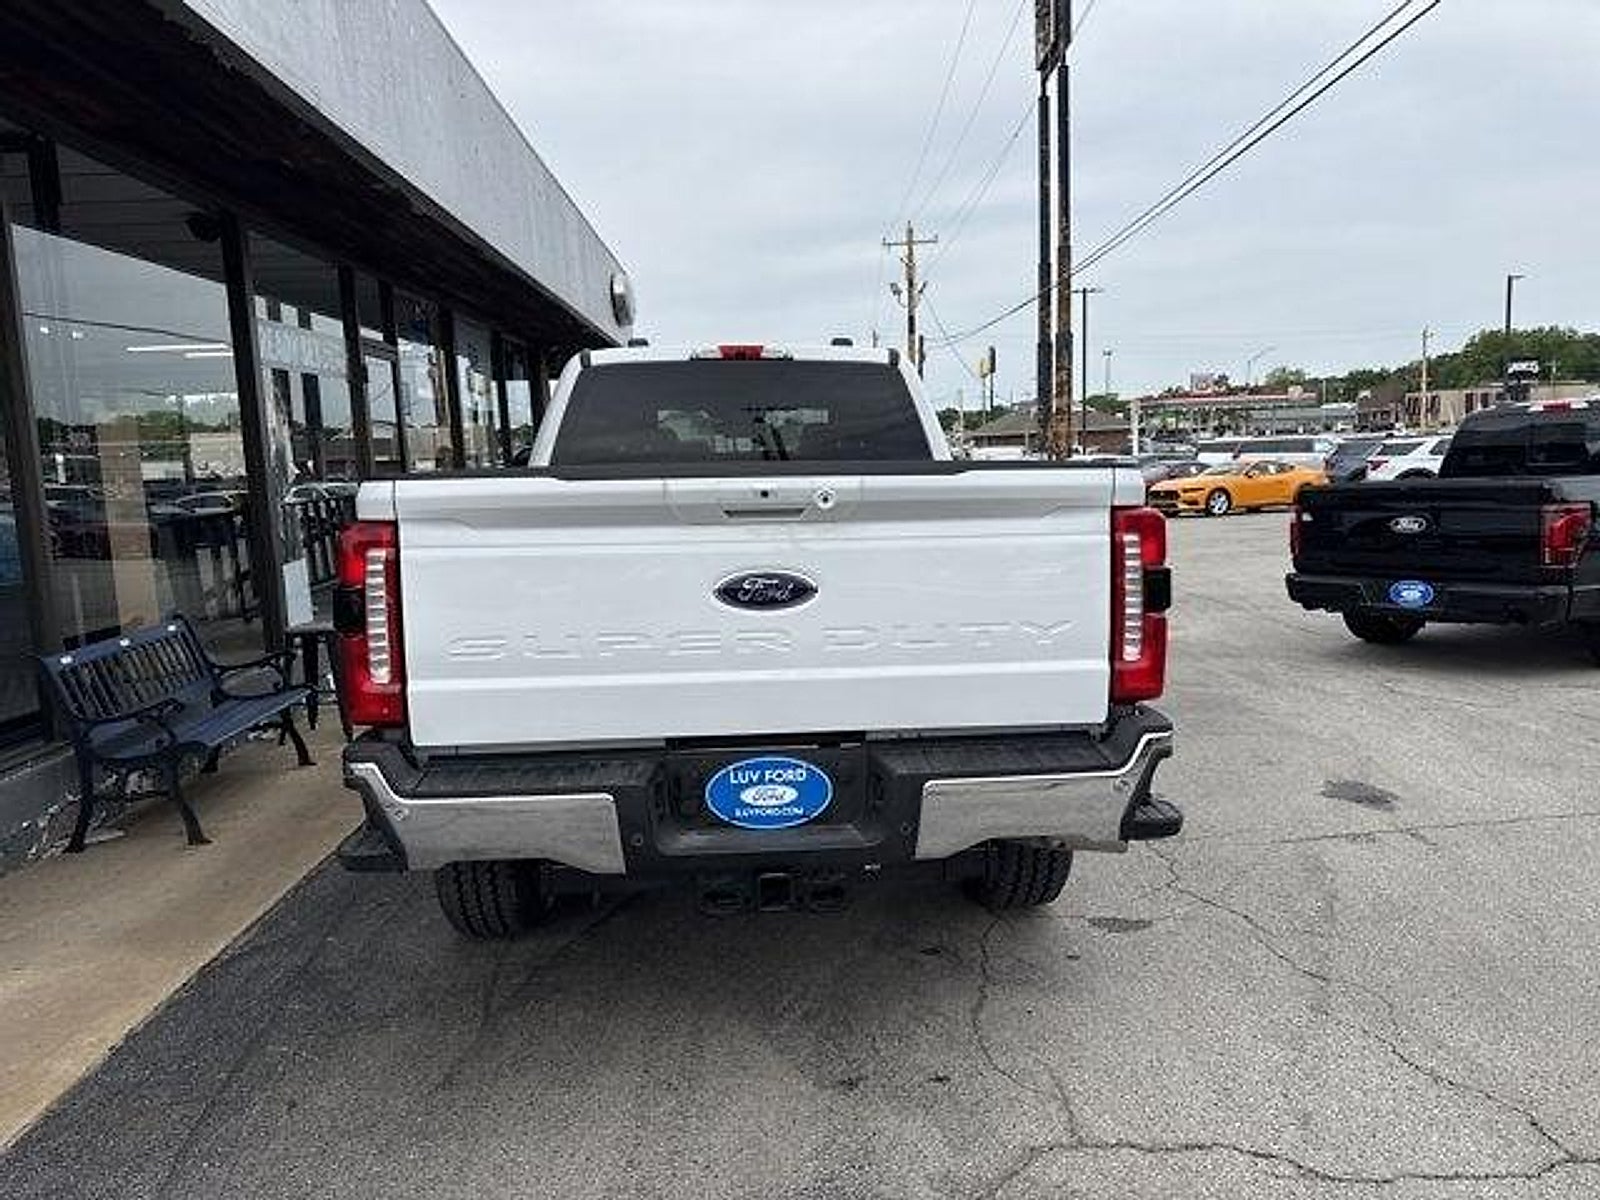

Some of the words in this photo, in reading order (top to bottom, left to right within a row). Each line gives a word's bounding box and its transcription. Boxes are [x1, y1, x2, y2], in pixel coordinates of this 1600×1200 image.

[737, 577, 794, 602] Ford
[449, 627, 792, 660] SUPER
[820, 619, 1074, 650] DUTY
[729, 769, 760, 784] LUV
[765, 767, 807, 783] FORD
[752, 786, 787, 802] Ford
